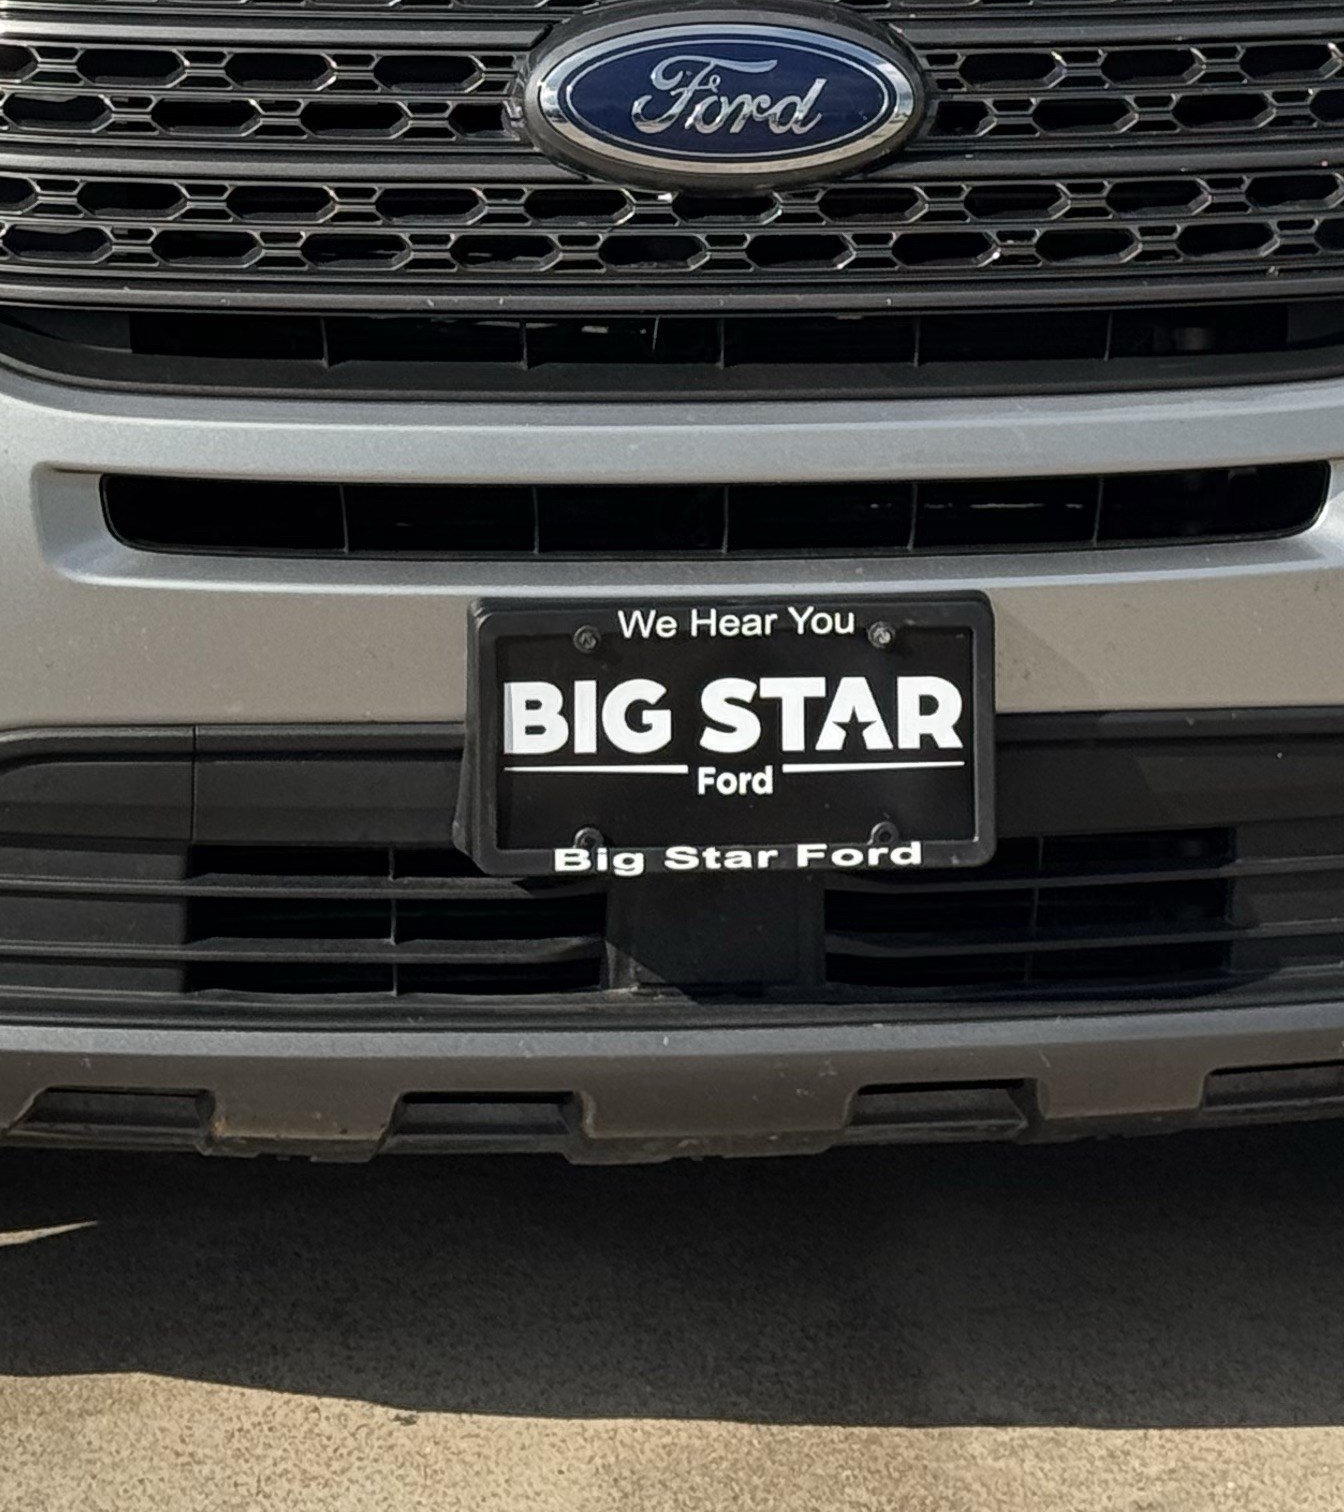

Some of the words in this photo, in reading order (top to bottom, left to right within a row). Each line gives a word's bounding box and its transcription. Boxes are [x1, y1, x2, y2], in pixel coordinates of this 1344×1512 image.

[631, 54, 827, 135] Ford
[617, 609, 678, 639] We
[689, 607, 778, 637] Hear
[787, 606, 855, 635] You
[503, 678, 672, 755] BIG
[699, 675, 964, 753] STAR
[697, 765, 774, 795] Ford
[554, 847, 645, 877] Big
[663, 844, 778, 870] Star
[796, 841, 923, 868] Ford
